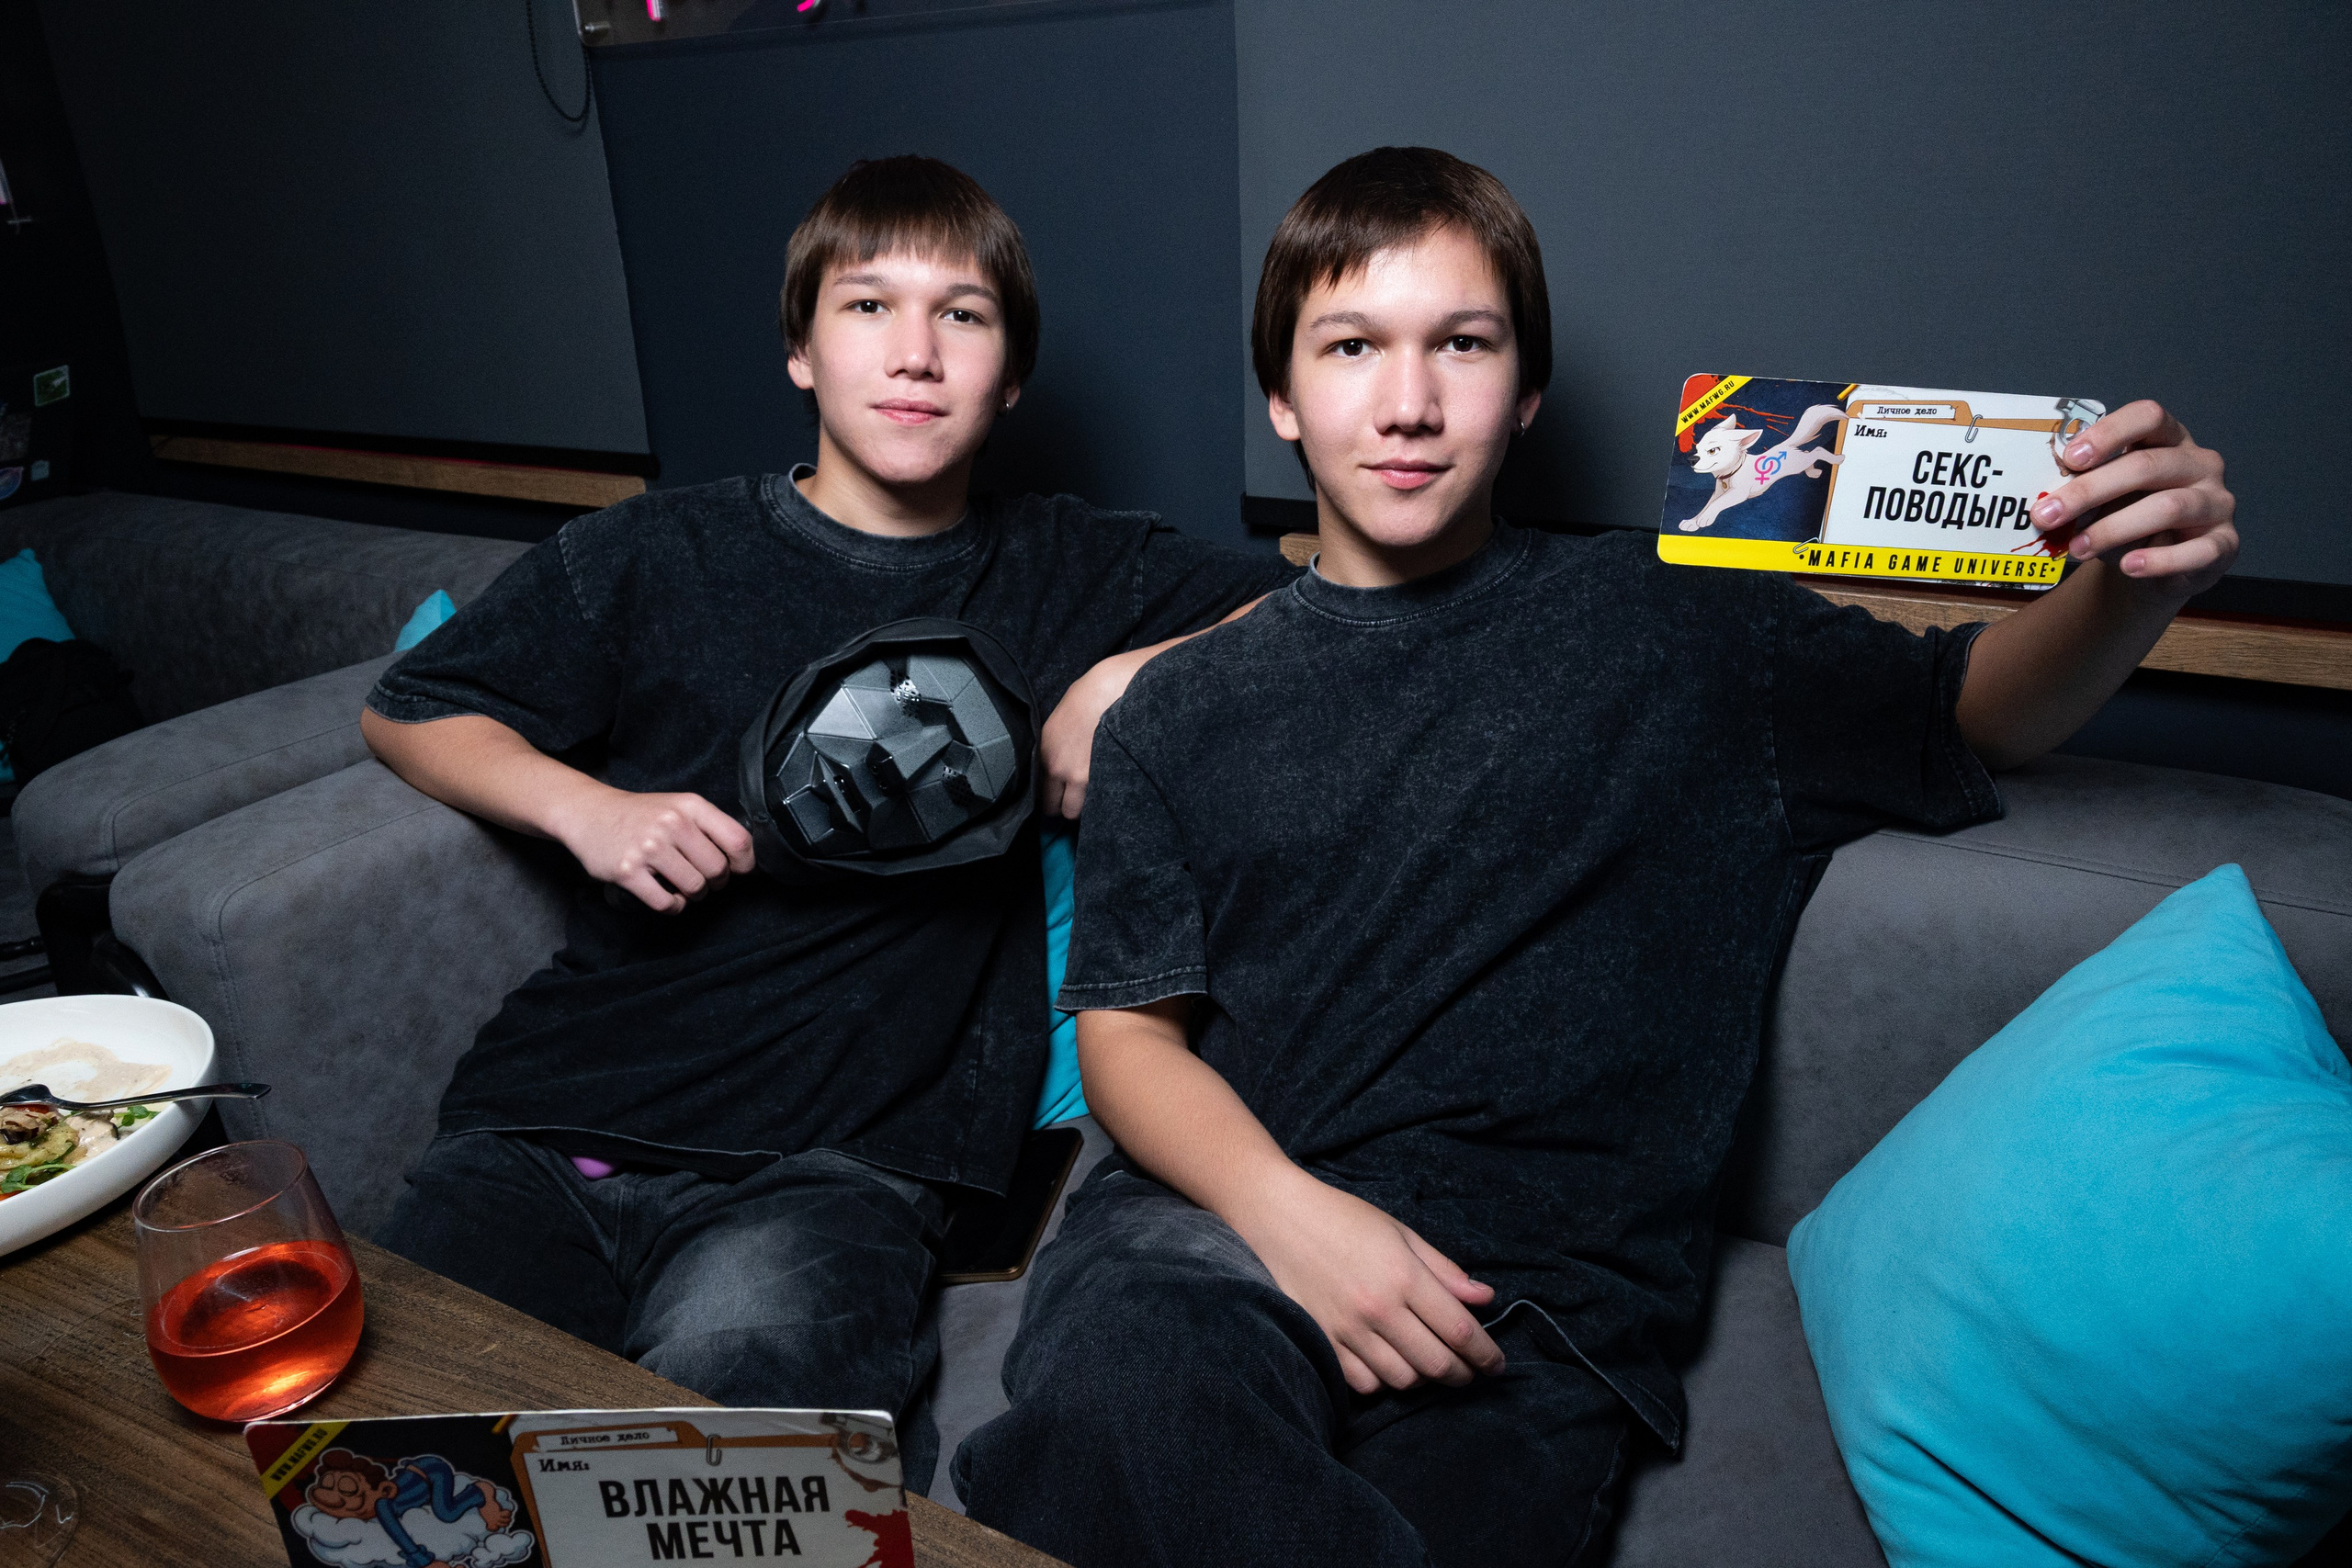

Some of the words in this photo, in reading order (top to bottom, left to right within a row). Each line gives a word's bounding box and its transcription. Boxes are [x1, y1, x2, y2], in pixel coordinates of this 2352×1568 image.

[1680, 380, 1736, 423] WWW.MAFWG.RU
[1877, 406, 1911, 416] Личное
[1915, 408, 1939, 416] дело
[1854, 423, 1889, 438] Имя:
[1912, 450, 2003, 489] СЕКС-
[1887, 554, 1942, 573] GAME
[560, 1434, 610, 1446] Личное
[616, 1430, 650, 1443] дело
[538, 1457, 591, 1473] Имя:
[598, 1474, 831, 1518] ВЛАЖНАЯ
[646, 1518, 802, 1561] МЕЧТА
